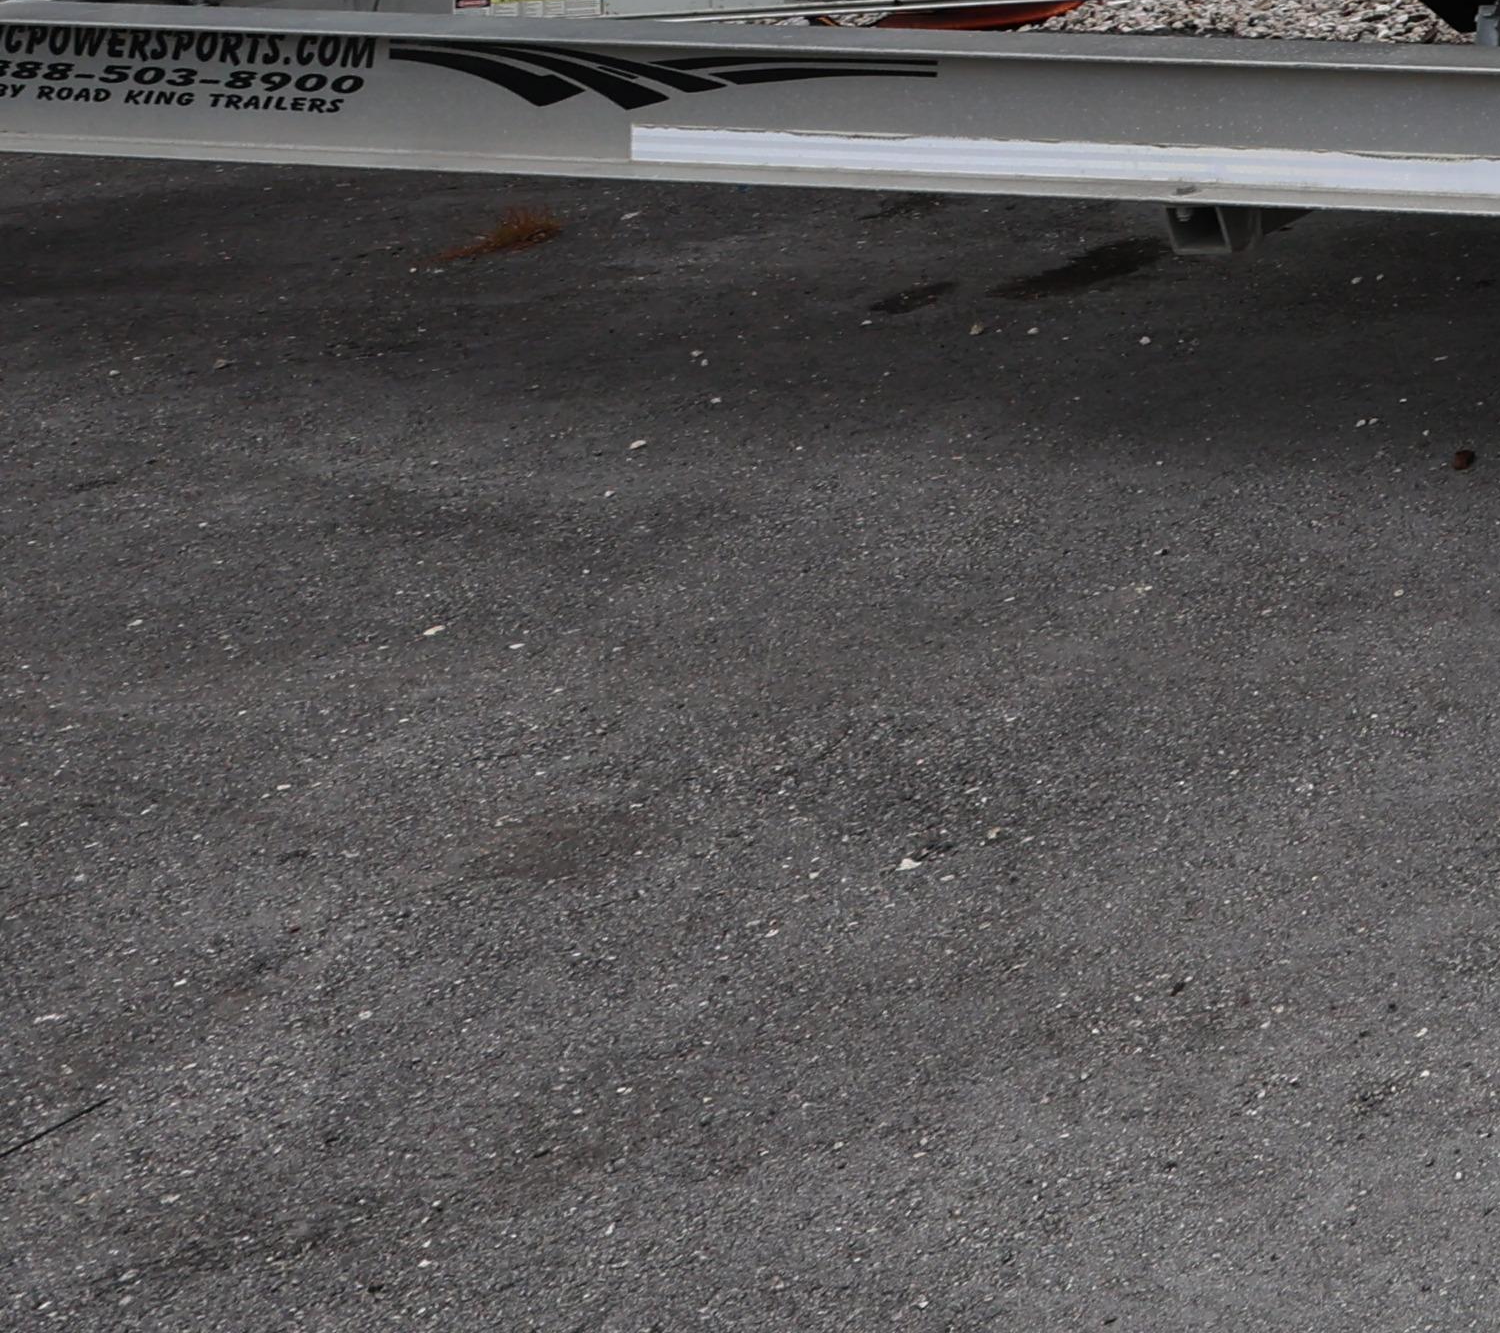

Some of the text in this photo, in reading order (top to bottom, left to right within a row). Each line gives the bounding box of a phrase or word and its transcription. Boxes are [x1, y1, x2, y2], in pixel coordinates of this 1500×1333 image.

[0, 24, 377, 69] CPOWERSPORTS.COM
[37, 85, 112, 103] ROAD
[124, 89, 196, 107] KING
[209, 93, 345, 114] TRAILERS
